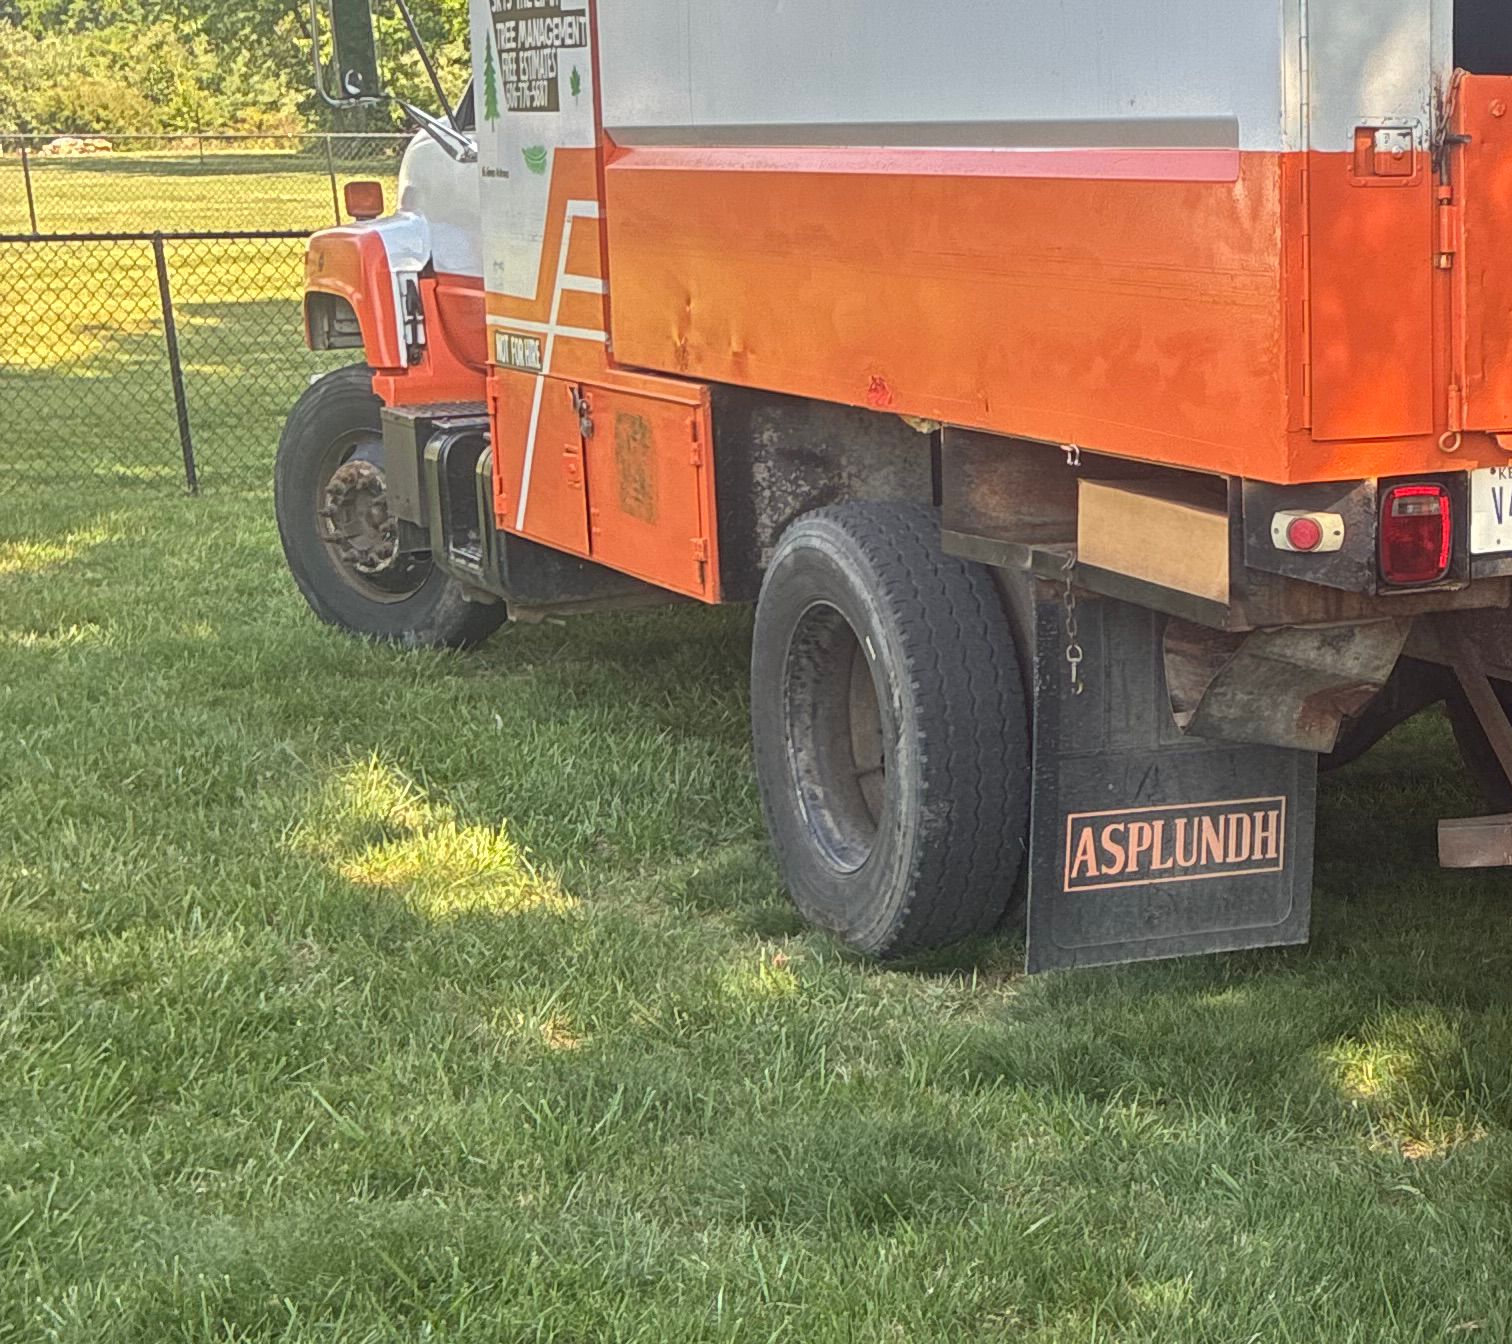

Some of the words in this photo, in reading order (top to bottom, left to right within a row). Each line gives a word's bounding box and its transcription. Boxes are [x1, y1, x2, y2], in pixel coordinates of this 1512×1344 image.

[496, 20, 516, 49] TREE
[518, 16, 587, 48] MANAGEMENT
[495, 333, 509, 363] NOT
[511, 336, 524, 367] FOR
[1071, 810, 1279, 879] ASPLUNDH
